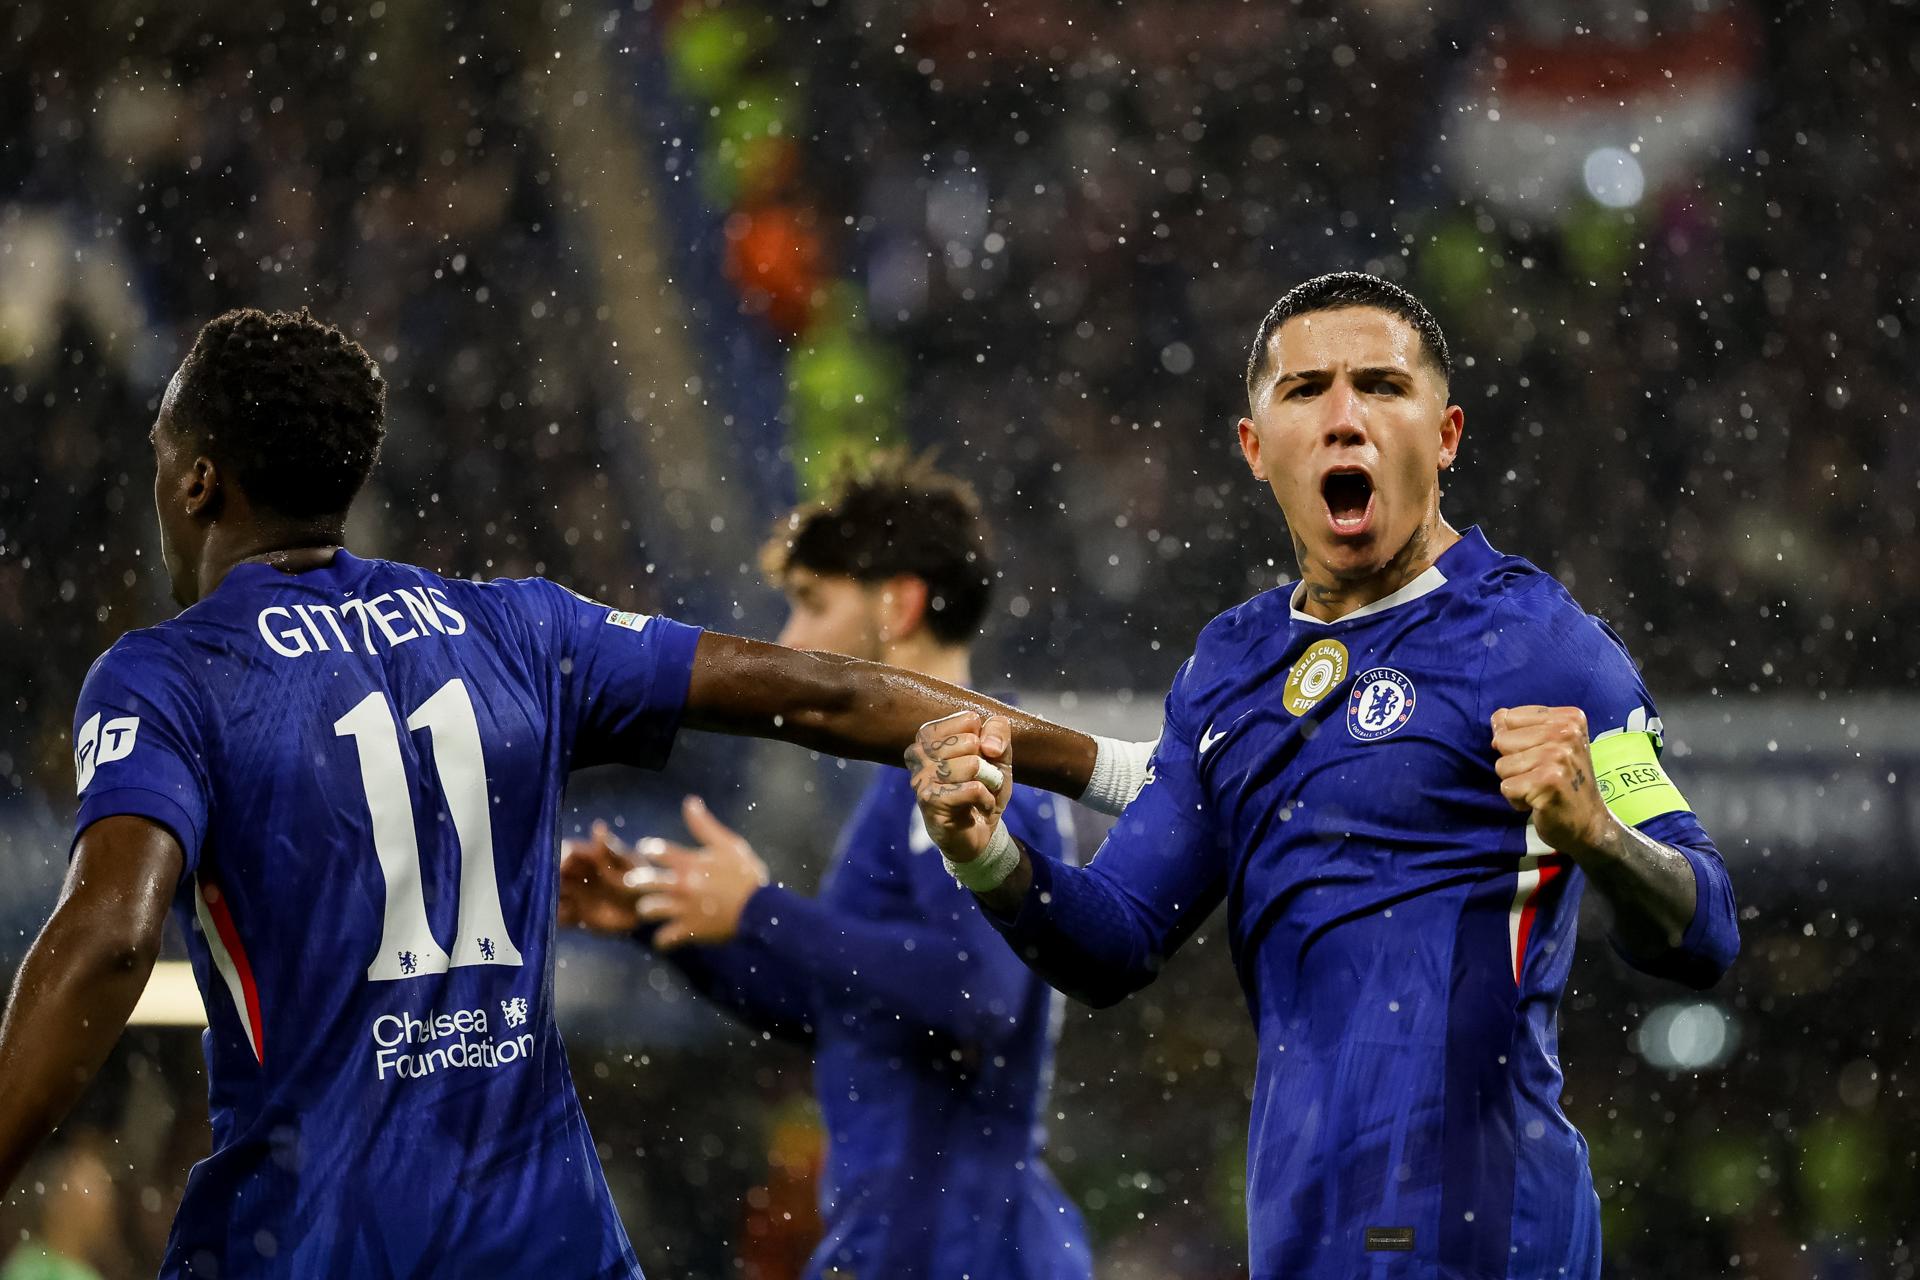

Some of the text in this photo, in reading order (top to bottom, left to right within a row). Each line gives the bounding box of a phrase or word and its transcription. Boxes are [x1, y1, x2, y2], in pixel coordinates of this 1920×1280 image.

[257, 586, 467, 658] GITTENS
[1291, 646, 1343, 688] WORLD CHAMPIONS
[1363, 670, 1408, 691] CHELSEA
[333, 678, 524, 982] 11
[373, 1008, 488, 1047] Chelsea
[376, 1033, 535, 1080] Foundation
